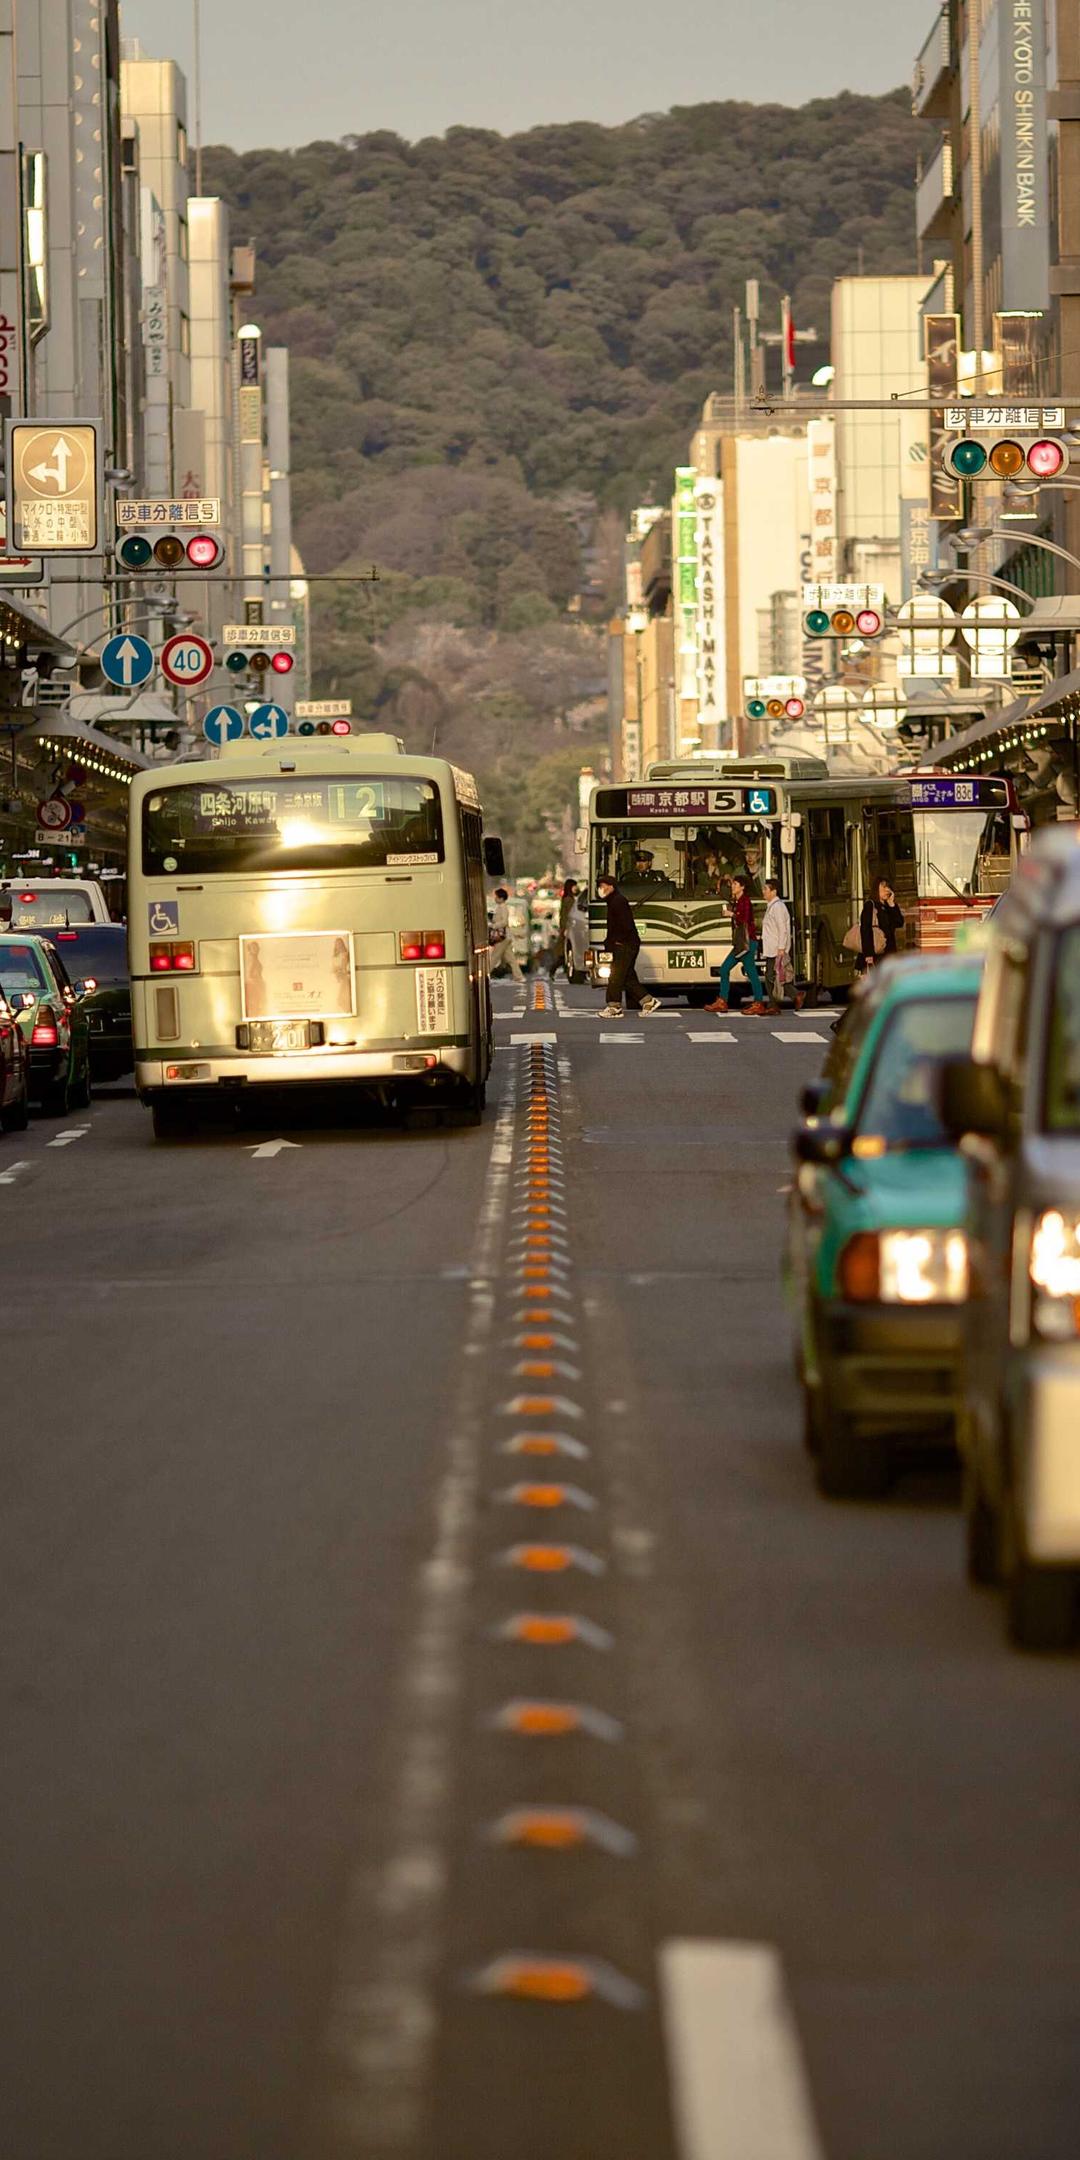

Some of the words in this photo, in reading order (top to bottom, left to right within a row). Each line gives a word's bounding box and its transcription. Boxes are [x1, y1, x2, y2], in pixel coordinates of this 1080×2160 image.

[1013, 22, 1033, 84] KYOTO
[1014, 90, 1034, 168] SHINKIN
[1016, 173, 1036, 227] BANK
[121, 503, 215, 521] 歩車分離信号
[701, 517, 716, 706] TAKASHIMAYA
[226, 629, 292, 641] 歩車分離信号
[173, 649, 201, 671] 40
[200, 791, 278, 816] 四条河原町
[658, 791, 705, 806] 京都駅
[714, 791, 737, 811] 5
[212, 817, 237, 827] Shijo
